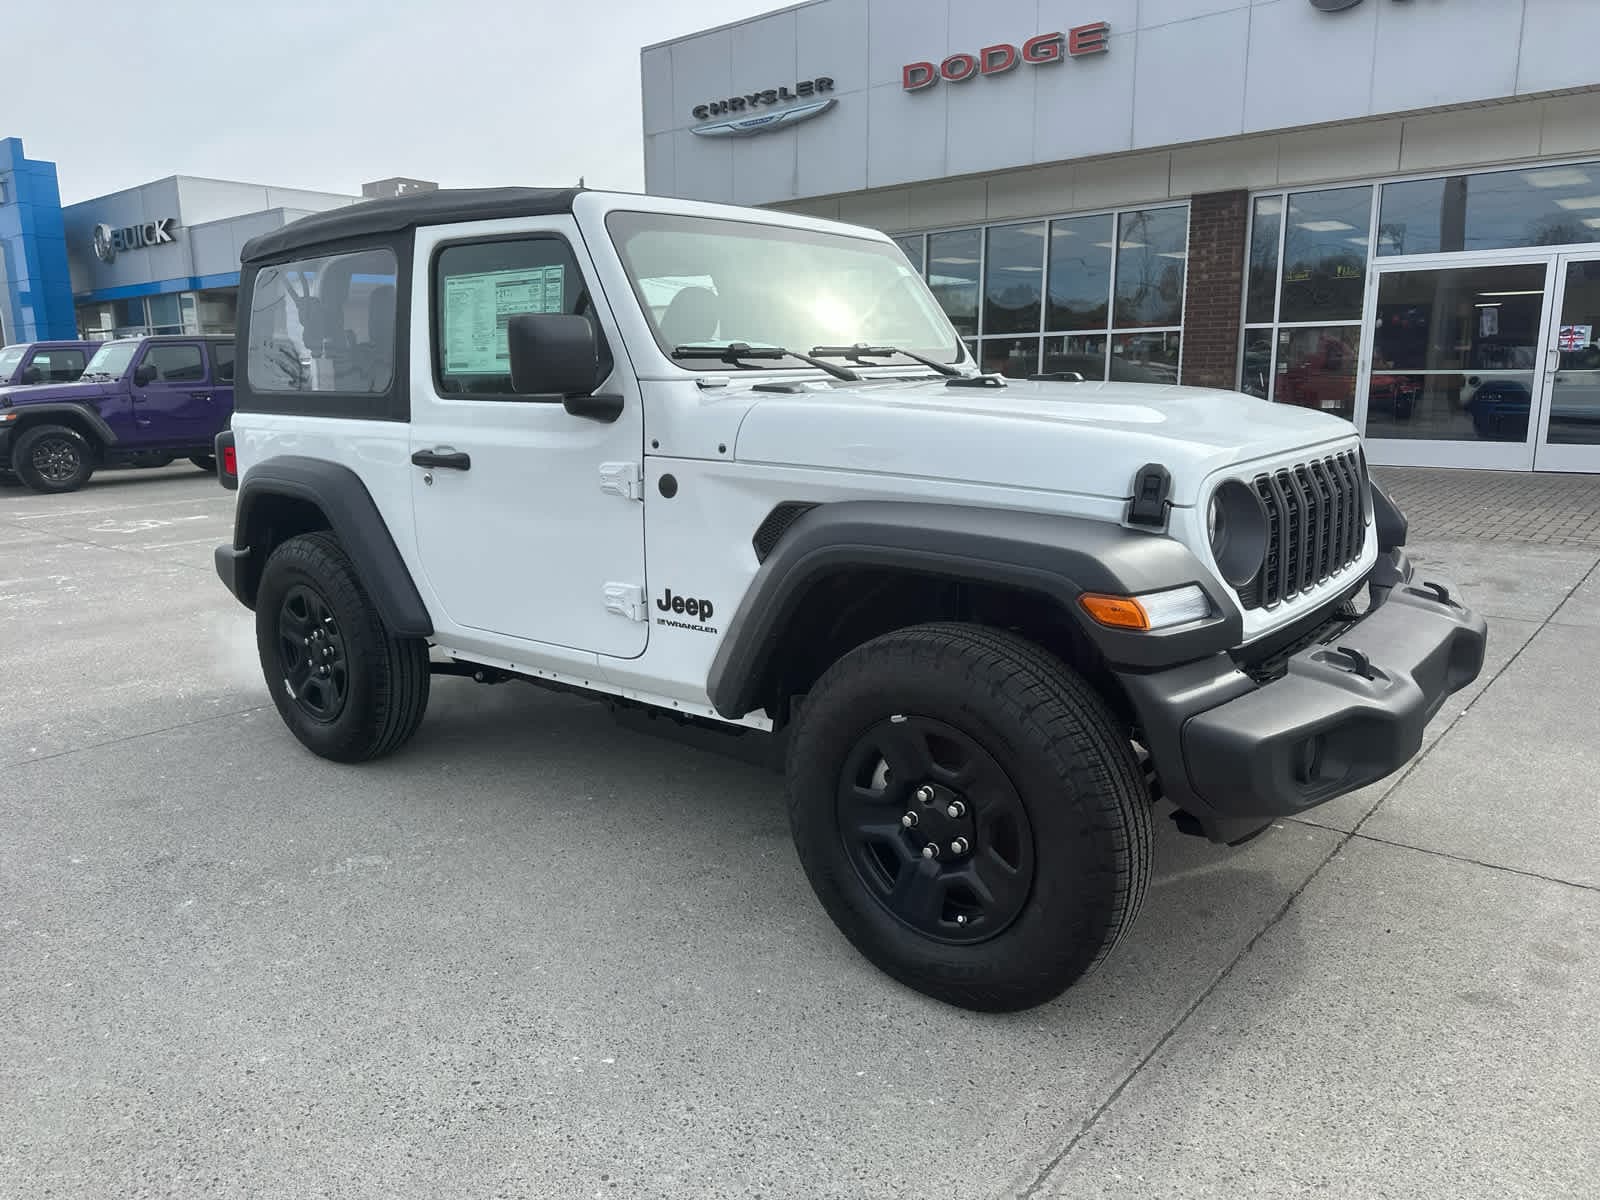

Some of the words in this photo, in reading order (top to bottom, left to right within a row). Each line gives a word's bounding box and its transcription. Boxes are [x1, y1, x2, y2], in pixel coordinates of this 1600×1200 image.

[903, 21, 1110, 93] DODGE
[692, 77, 834, 119] CHRYSLER
[111, 218, 175, 251] BUICK
[656, 588, 714, 622] Jeep
[665, 620, 718, 634] WRANGLER
